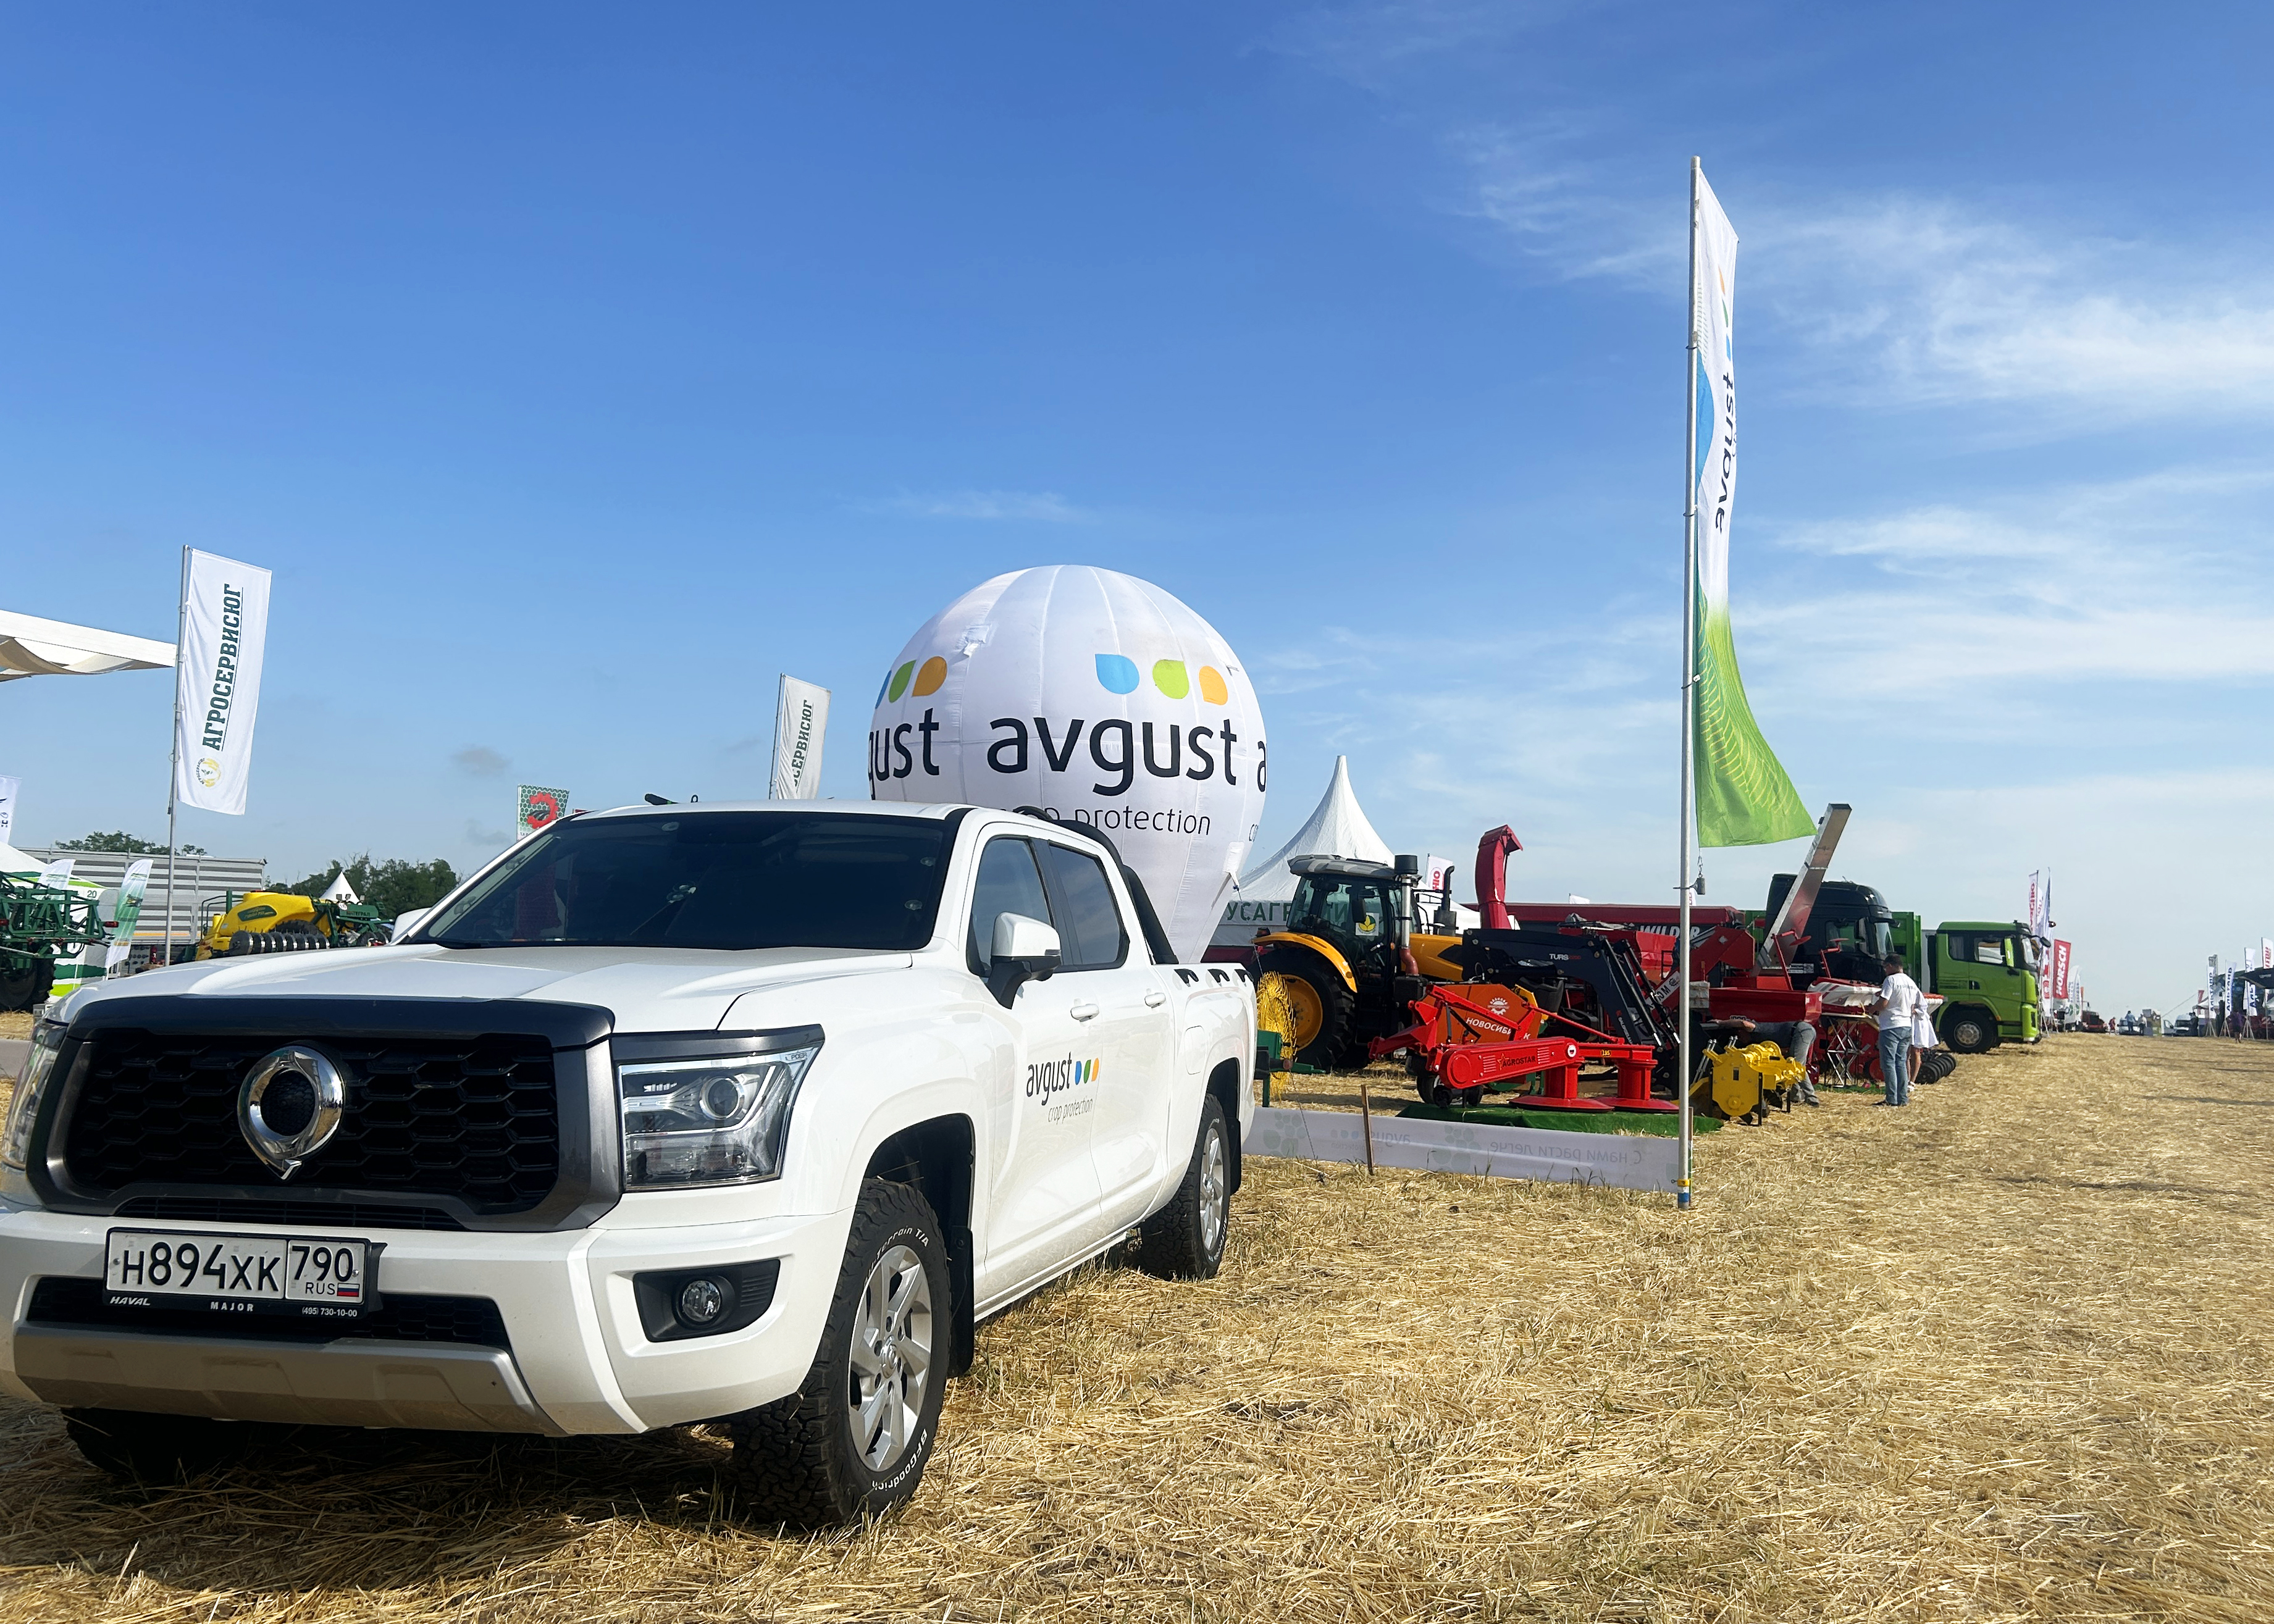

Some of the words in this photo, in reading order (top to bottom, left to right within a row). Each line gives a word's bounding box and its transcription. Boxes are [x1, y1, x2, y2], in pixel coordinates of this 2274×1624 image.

[203, 584, 241, 751] АГРОСЕРВИСЮГ
[988, 716, 1237, 797] avgust
[1075, 805, 1210, 835] protection
[2056, 945, 2066, 995] HORSCH
[1502, 1056, 1536, 1067] AGROSTAR
[1026, 1052, 1072, 1105] avgust
[1048, 1105, 1062, 1124] crop
[1062, 1096, 1093, 1124] protection
[915, 1228, 929, 1247] T/A
[291, 1245, 353, 1283] 790
[110, 1296, 151, 1307] HAVAL
[305, 1282, 335, 1295] RUS
[210, 1301, 254, 1312] MAJOR
[872, 1428, 928, 1492] BFGoodrich
